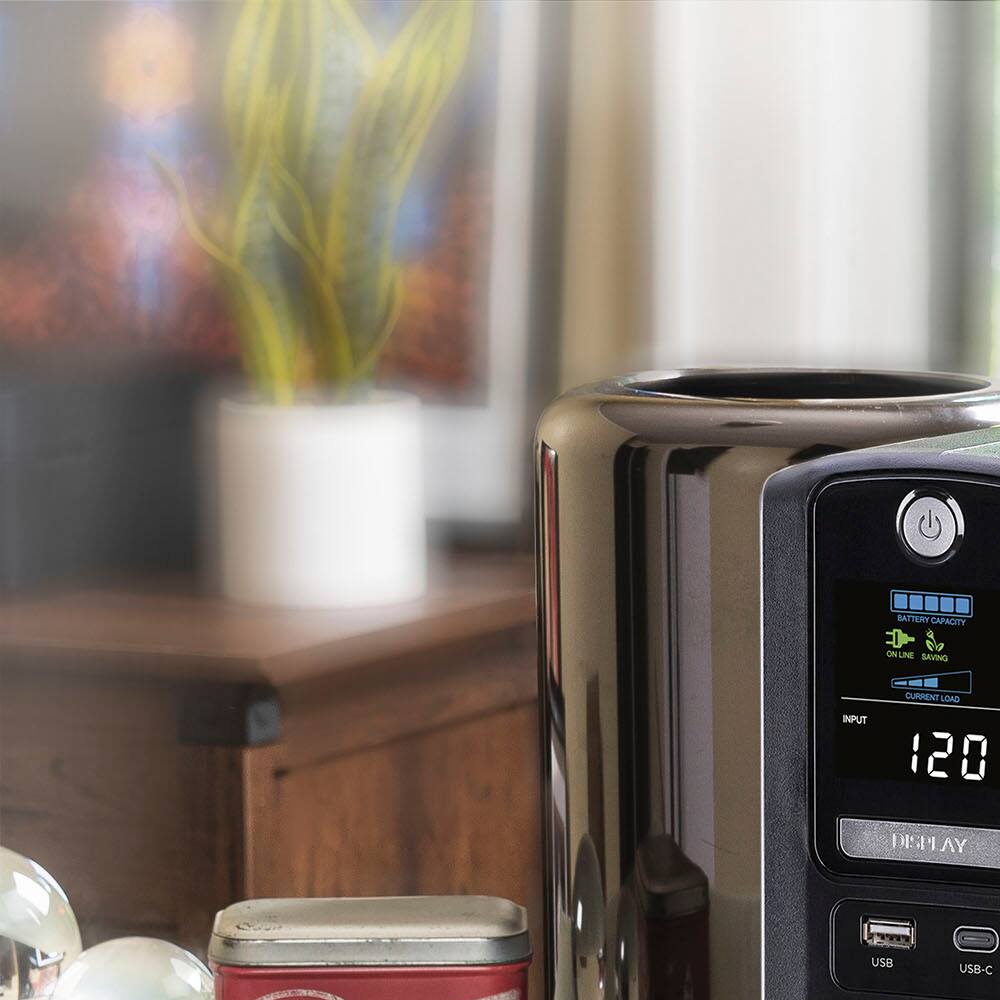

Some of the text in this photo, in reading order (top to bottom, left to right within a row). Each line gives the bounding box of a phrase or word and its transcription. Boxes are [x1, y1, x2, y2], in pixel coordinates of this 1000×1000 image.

[897, 614, 966, 626] BATTERY CAPACITY
[886, 649, 915, 660] ON LINE
[921, 652, 948, 662] SAVING
[905, 691, 961, 704] CURRENT LOAD
[842, 714, 868, 725] INPUT
[911, 731, 988, 781] 120
[892, 832, 967, 854] DISPLAY
[871, 957, 893, 969] USB
[959, 963, 993, 976] USB-C
